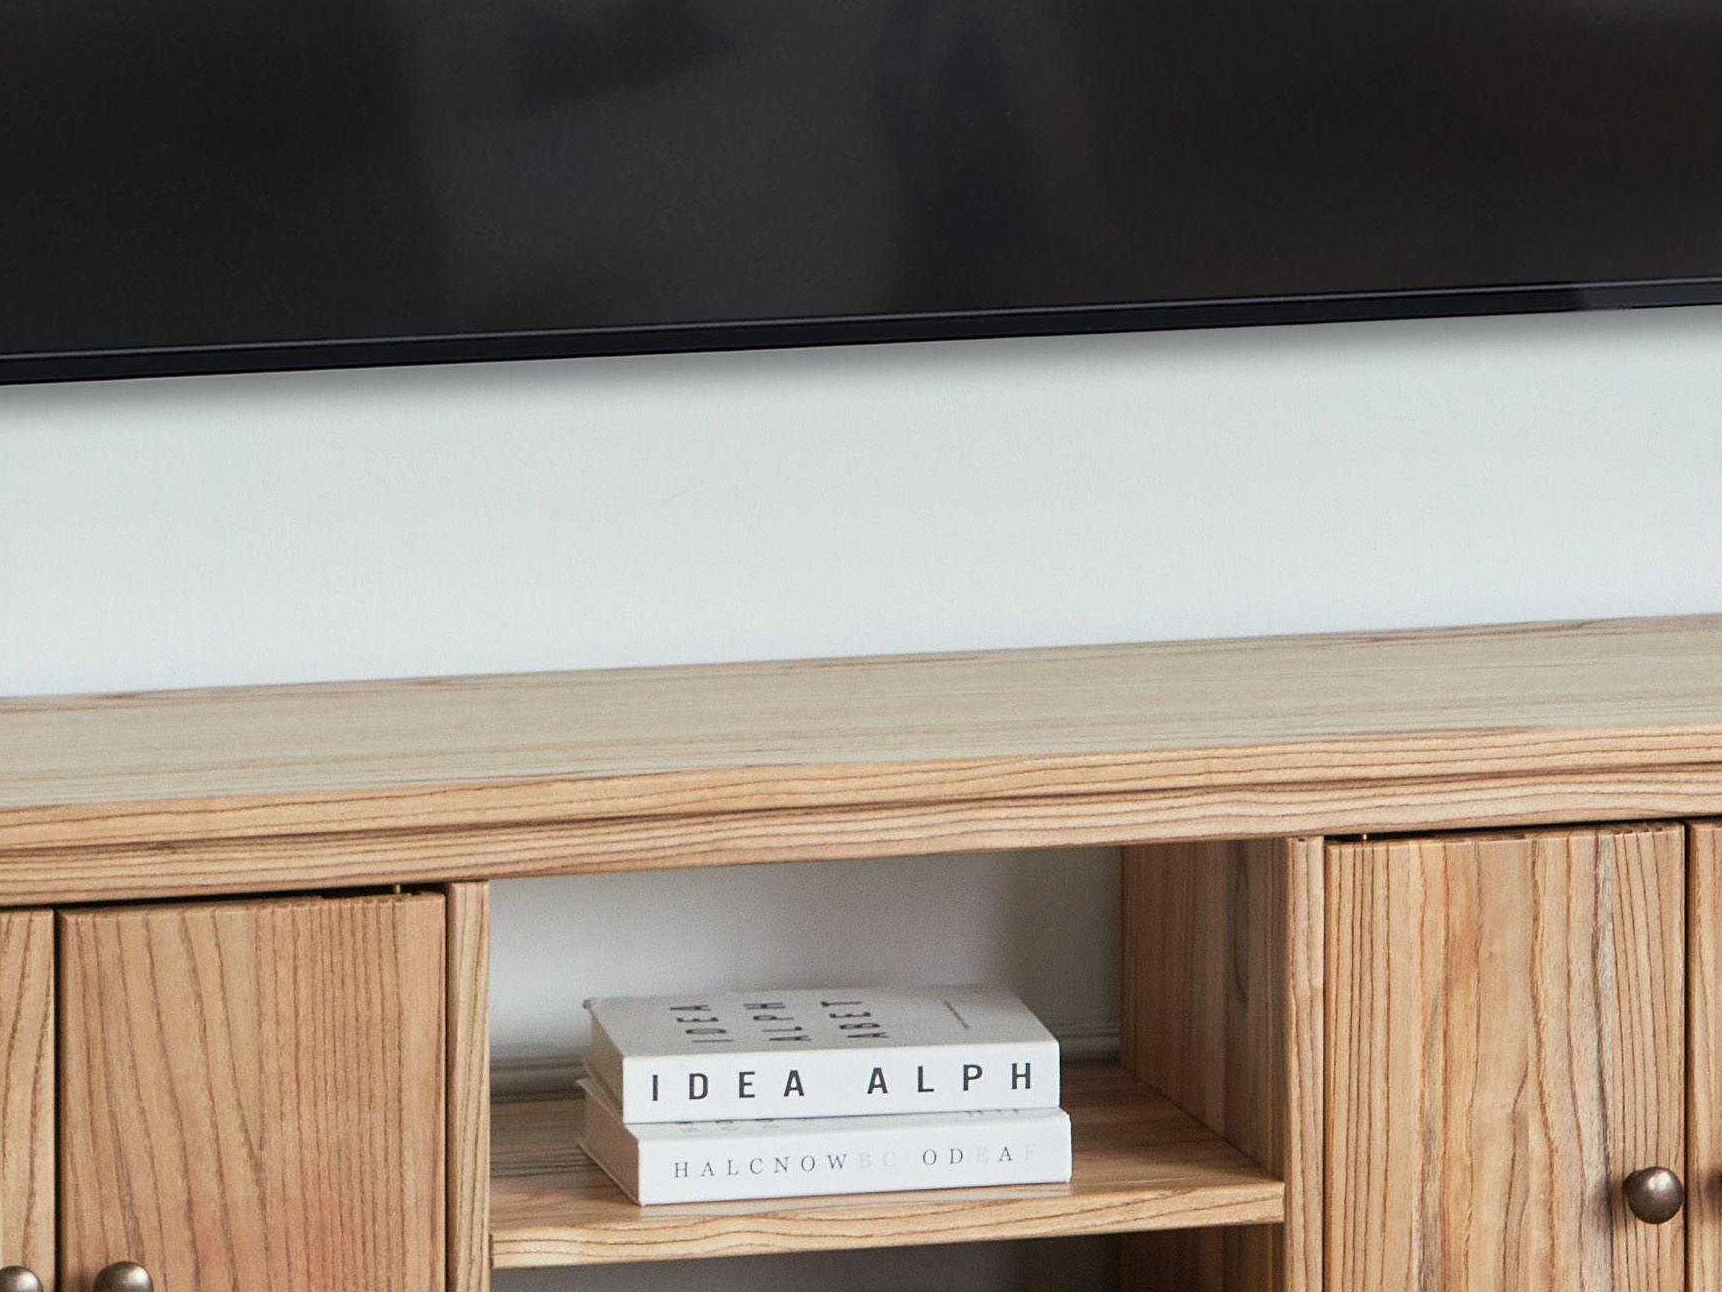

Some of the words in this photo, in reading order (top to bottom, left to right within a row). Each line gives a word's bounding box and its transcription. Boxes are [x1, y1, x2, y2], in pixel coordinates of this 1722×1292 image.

[669, 1004, 735, 1043] IDEA
[742, 1001, 813, 1042] ALPH
[820, 1000, 891, 1040] ABET
[651, 1069, 805, 1102] IDEA
[866, 1062, 1032, 1095] ALPH
